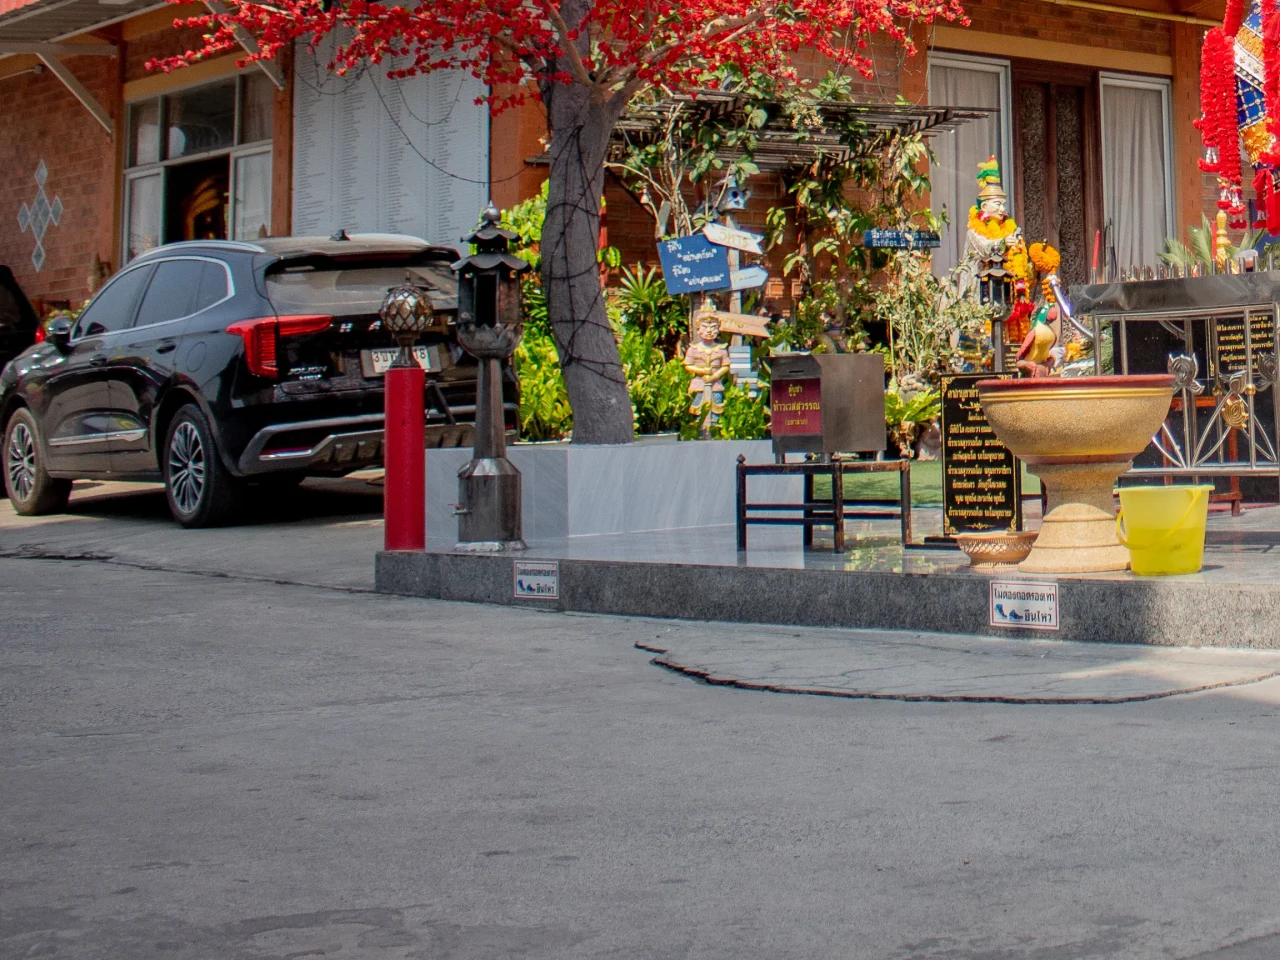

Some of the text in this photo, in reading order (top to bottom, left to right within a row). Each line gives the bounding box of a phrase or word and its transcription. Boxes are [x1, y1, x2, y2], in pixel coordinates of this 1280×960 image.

[773, 400, 821, 415] ท้าวเวสสุวรรณ
[994, 585, 1055, 602] ไม่ต้องถอดรองเท้า
[1024, 606, 1052, 623] ยืนไหว้
